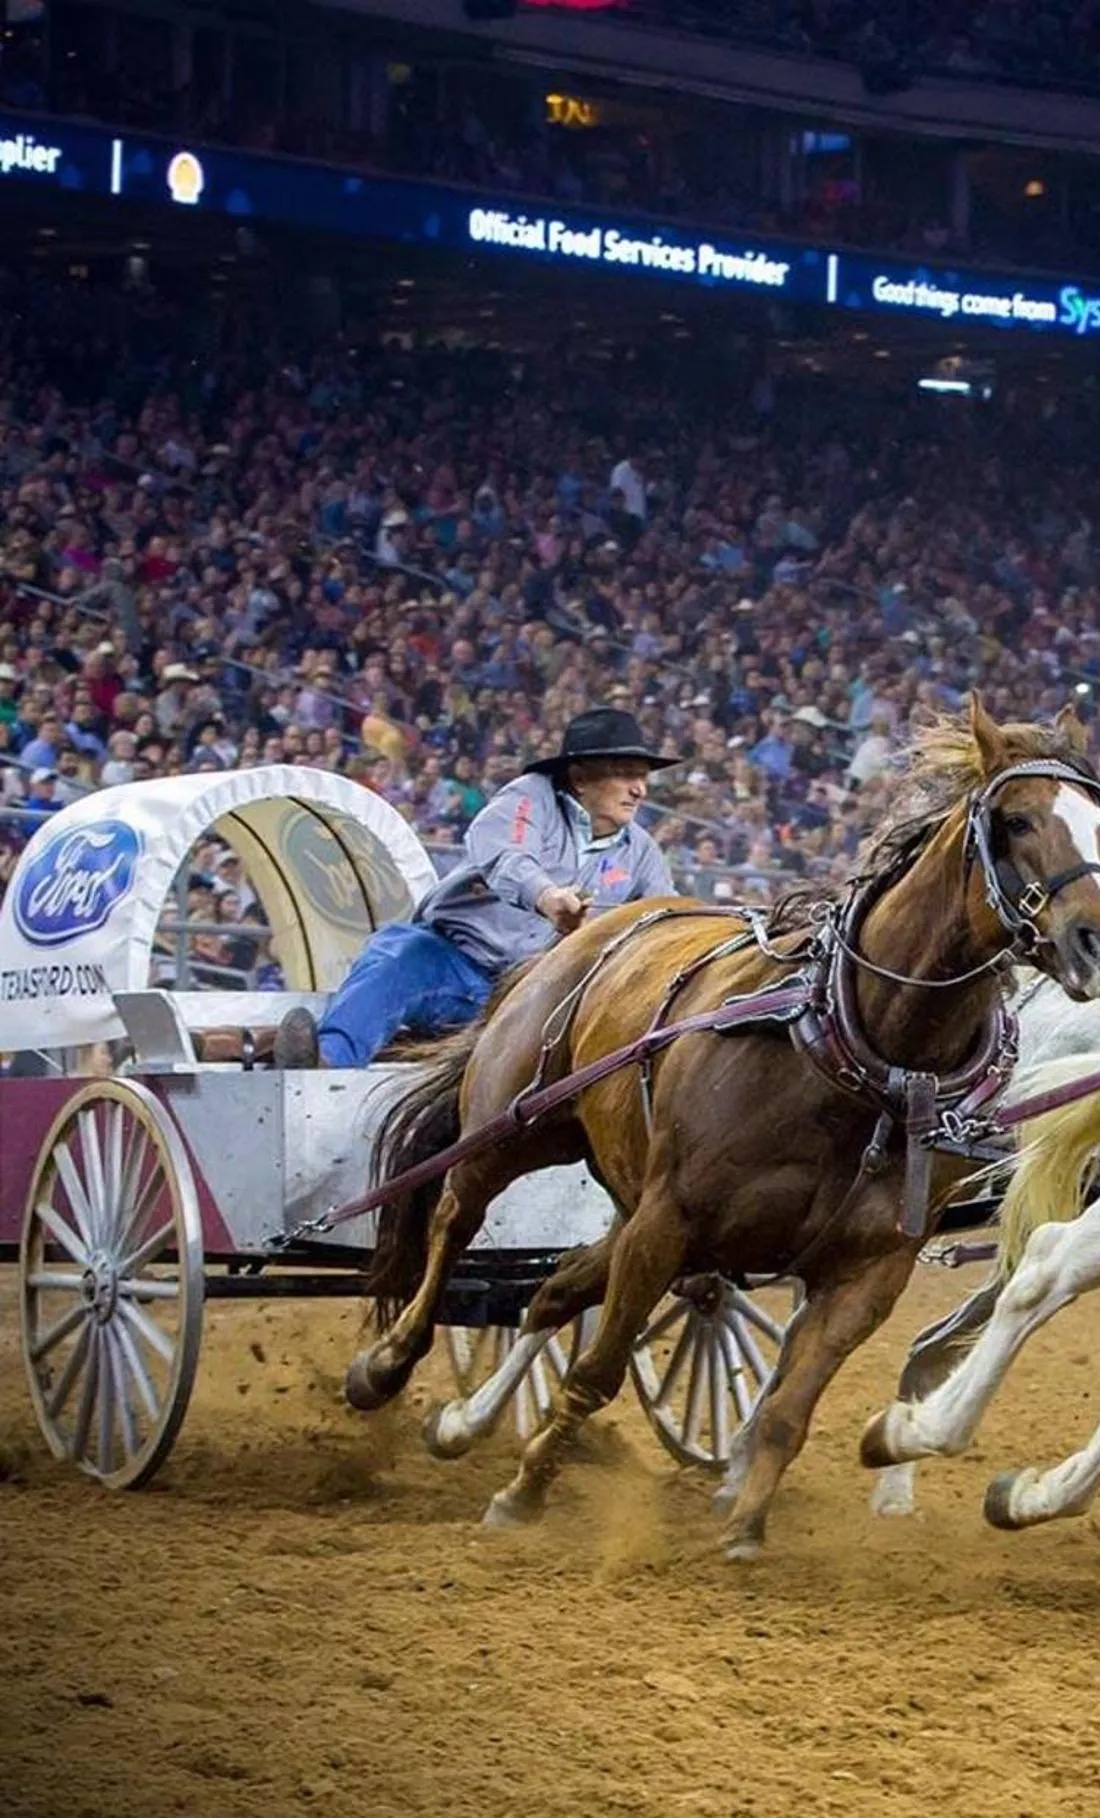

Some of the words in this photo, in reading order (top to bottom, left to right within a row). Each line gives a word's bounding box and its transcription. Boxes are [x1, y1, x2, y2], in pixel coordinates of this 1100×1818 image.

[469, 208, 546, 250] Official
[548, 220, 601, 259] Food
[603, 229, 696, 273] Services
[698, 243, 790, 286] Provider
[961, 293, 1012, 318] come
[1012, 292, 1056, 321] from
[27, 830, 125, 918] Ford
